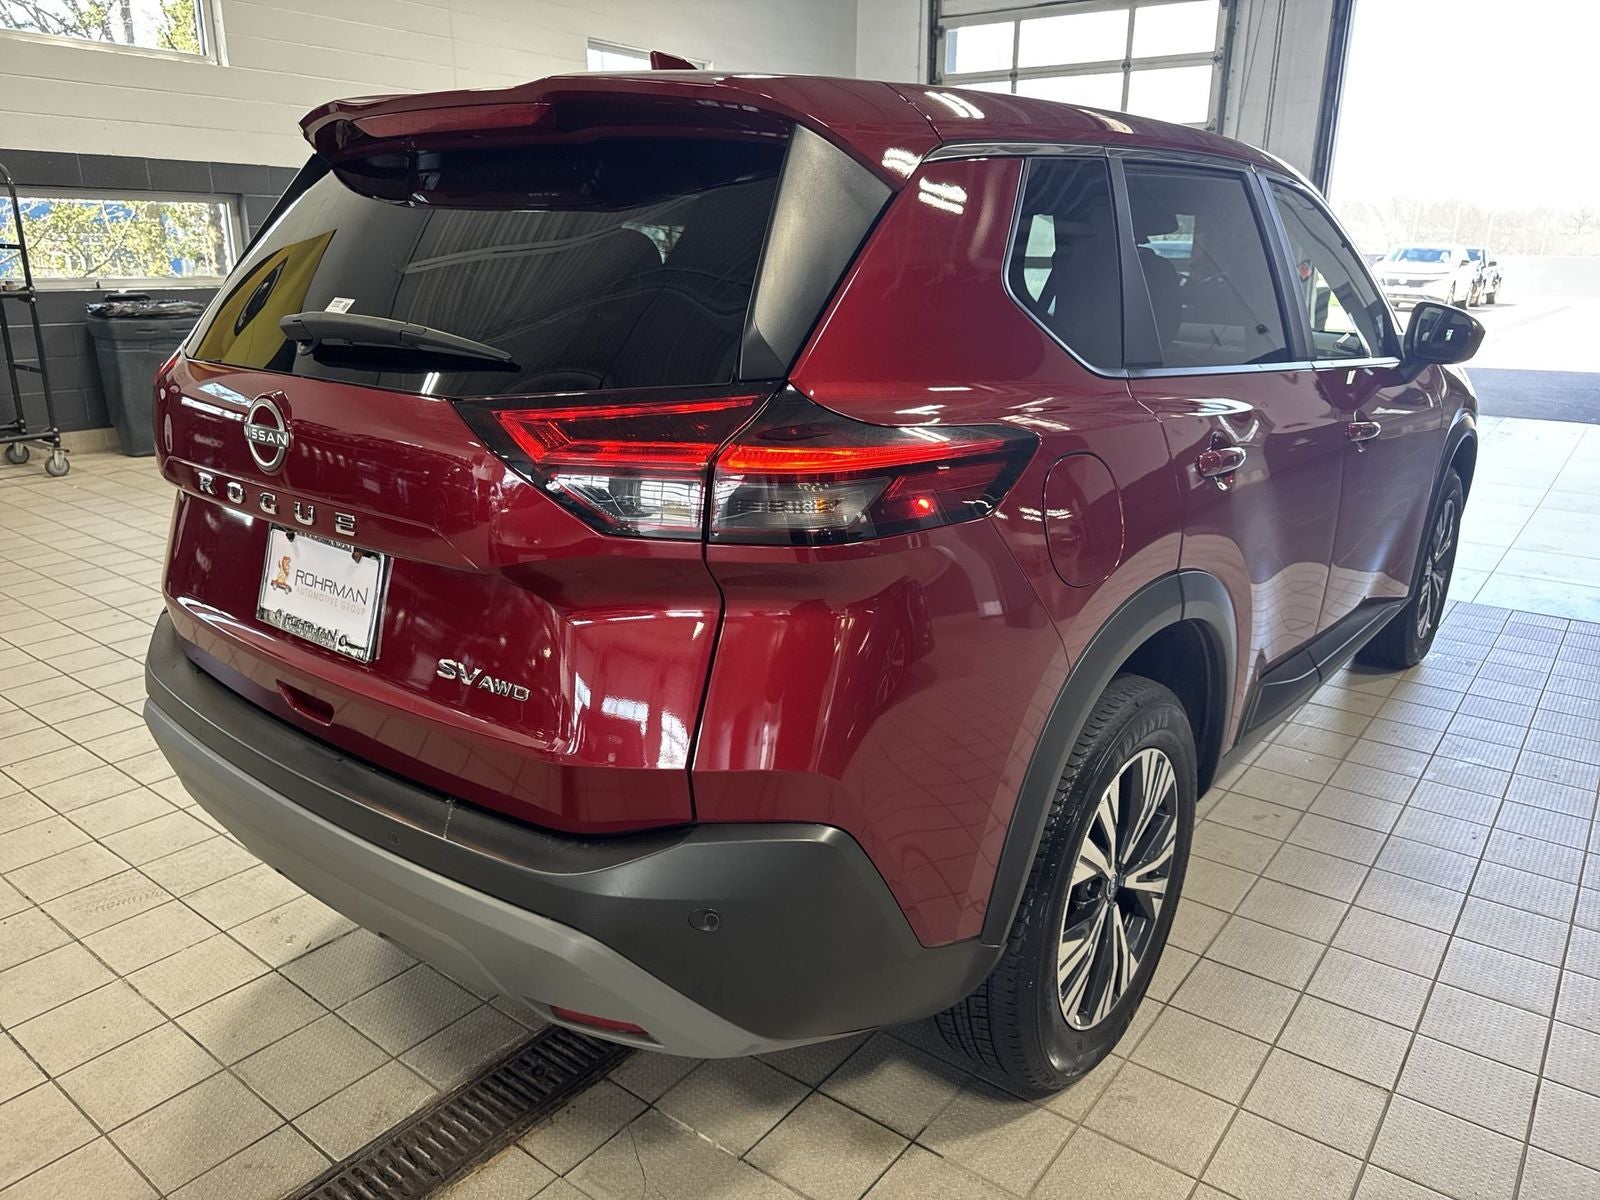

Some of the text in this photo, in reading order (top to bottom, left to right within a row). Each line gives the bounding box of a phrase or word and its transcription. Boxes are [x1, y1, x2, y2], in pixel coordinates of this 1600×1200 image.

[244, 424, 289, 446] NISSAN
[197, 471, 356, 537] ROGUE
[294, 569, 369, 606] ROHRMAN
[296, 586, 367, 616] AUTOMOTIVE GROUP
[436, 658, 531, 701] SV AWD
